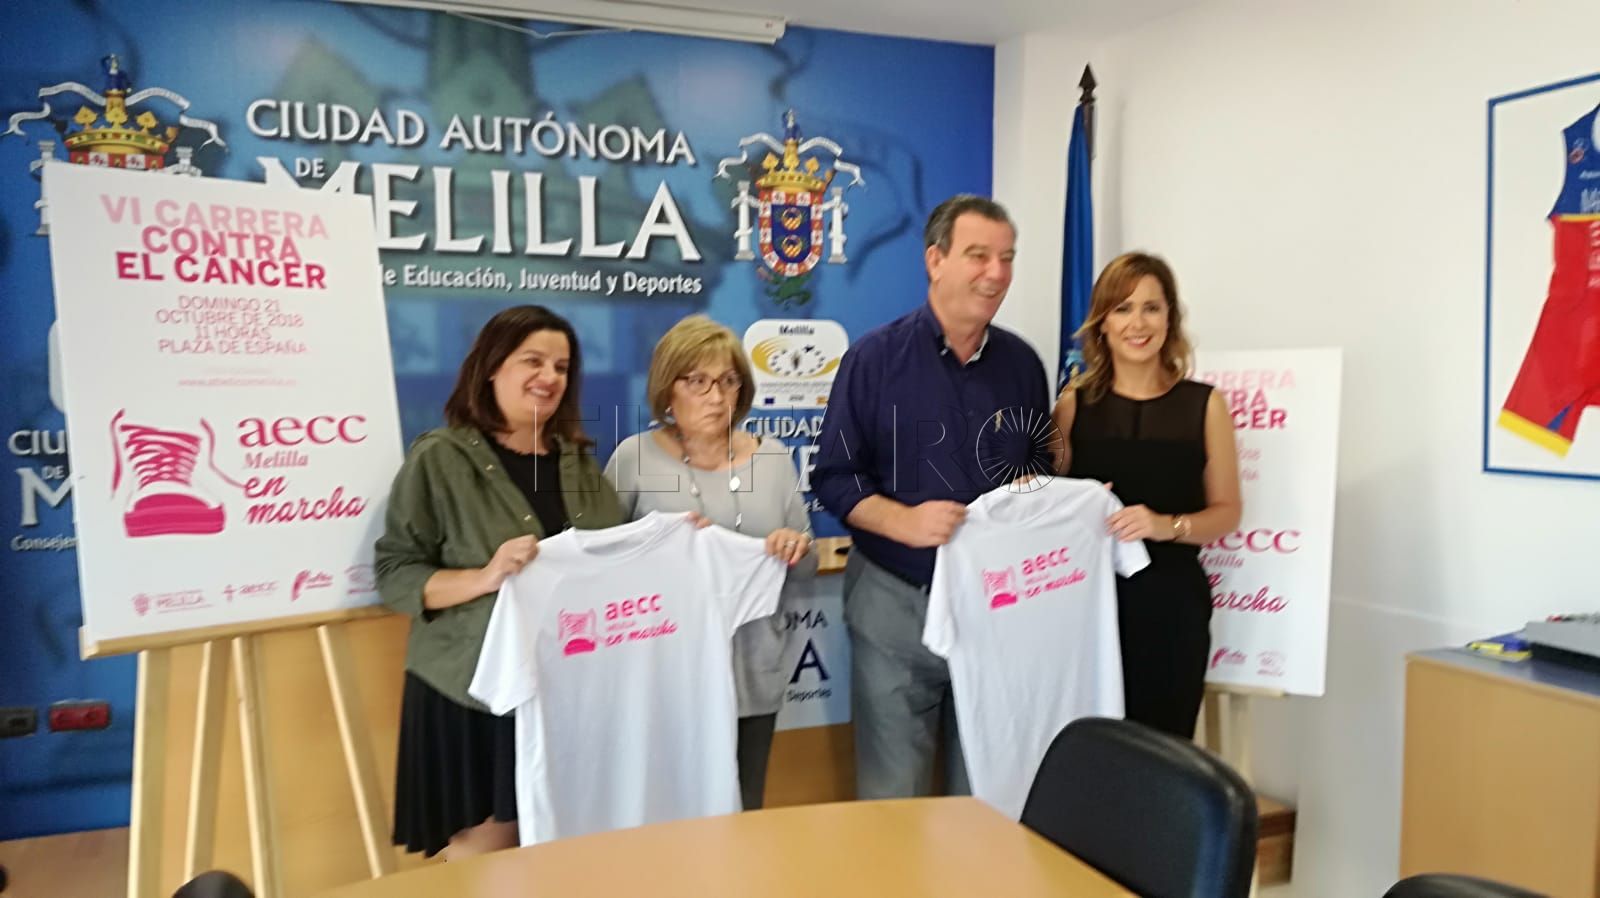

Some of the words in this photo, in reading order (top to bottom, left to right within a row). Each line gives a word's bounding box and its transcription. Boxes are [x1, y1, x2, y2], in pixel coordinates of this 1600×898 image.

[245, 98, 426, 147] CIUDAD
[438, 110, 698, 166] AUTÓNOMA
[295, 157, 326, 179] DE
[100, 194, 142, 225] VI
[154, 199, 329, 239] CARRERA
[141, 225, 302, 263] CONTRA
[115, 251, 164, 281] EL
[174, 249, 327, 289] CÁNCER
[403, 264, 514, 292] Educación,
[518, 268, 601, 291] Juventud
[605, 275, 618, 296] y
[623, 271, 703, 295] Deportes
[178, 295, 261, 312] DOMINGO
[264, 299, 281, 313] 21
[155, 309, 237, 325] OCTUBRE
[243, 312, 263, 326] DE
[267, 313, 304, 328] 2018
[215, 326, 273, 340] HORAS
[158, 339, 214, 354] PLAZA
[219, 340, 240, 354] DE
[245, 340, 308, 355] ESPAÑA
[238, 415, 368, 447] aecc
[1231, 408, 1288, 430] CER
[7, 430, 65, 456] CIU
[42, 465, 65, 480] DE
[244, 450, 308, 469] Melilla
[244, 476, 288, 498] en
[246, 486, 369, 524] marcha
[10, 535, 78, 552] Consejer
[1022, 546, 1071, 575] aecc
[605, 594, 662, 620] aecc
[1211, 586, 1289, 613] archa
